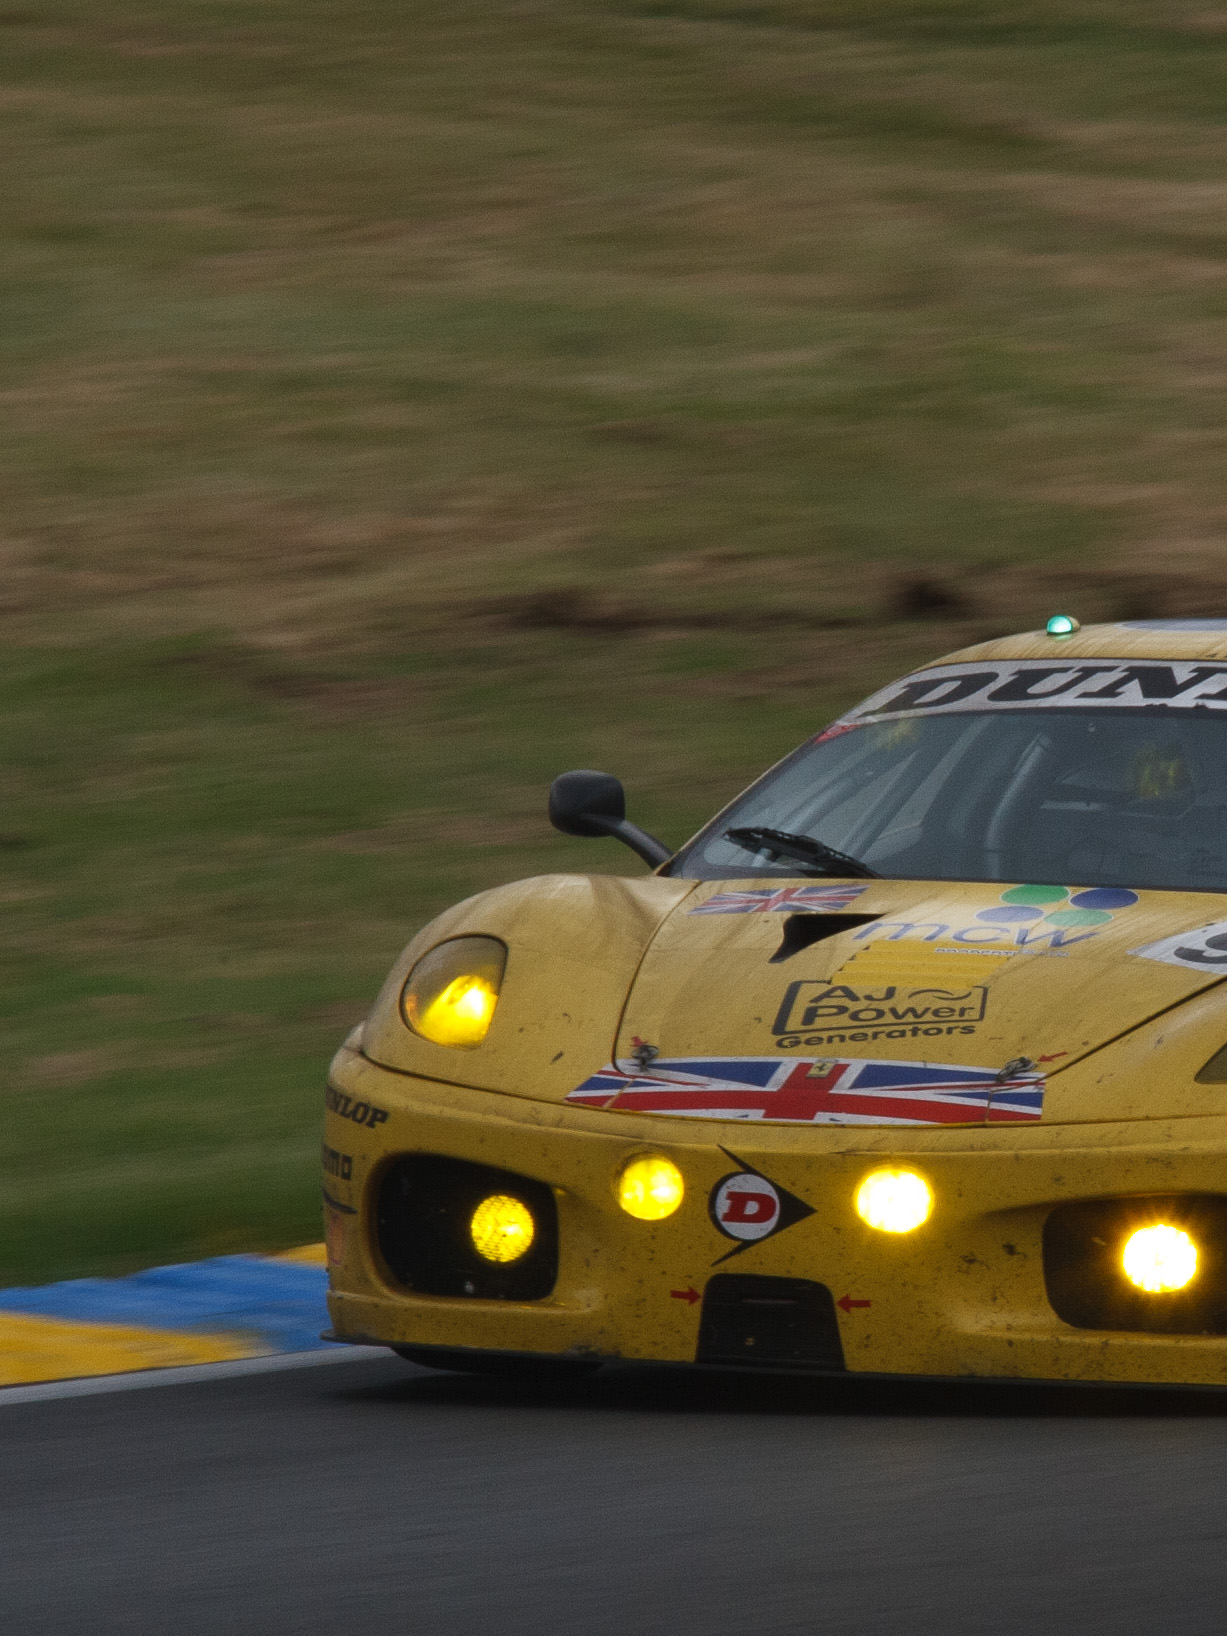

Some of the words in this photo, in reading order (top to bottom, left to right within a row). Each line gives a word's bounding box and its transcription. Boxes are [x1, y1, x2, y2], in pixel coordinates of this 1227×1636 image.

[853, 922, 1101, 947] mcw
[810, 986, 896, 1003] AJ
[801, 1002, 976, 1026] Power
[775, 1024, 976, 1049] Generators
[721, 1191, 776, 1223] D
